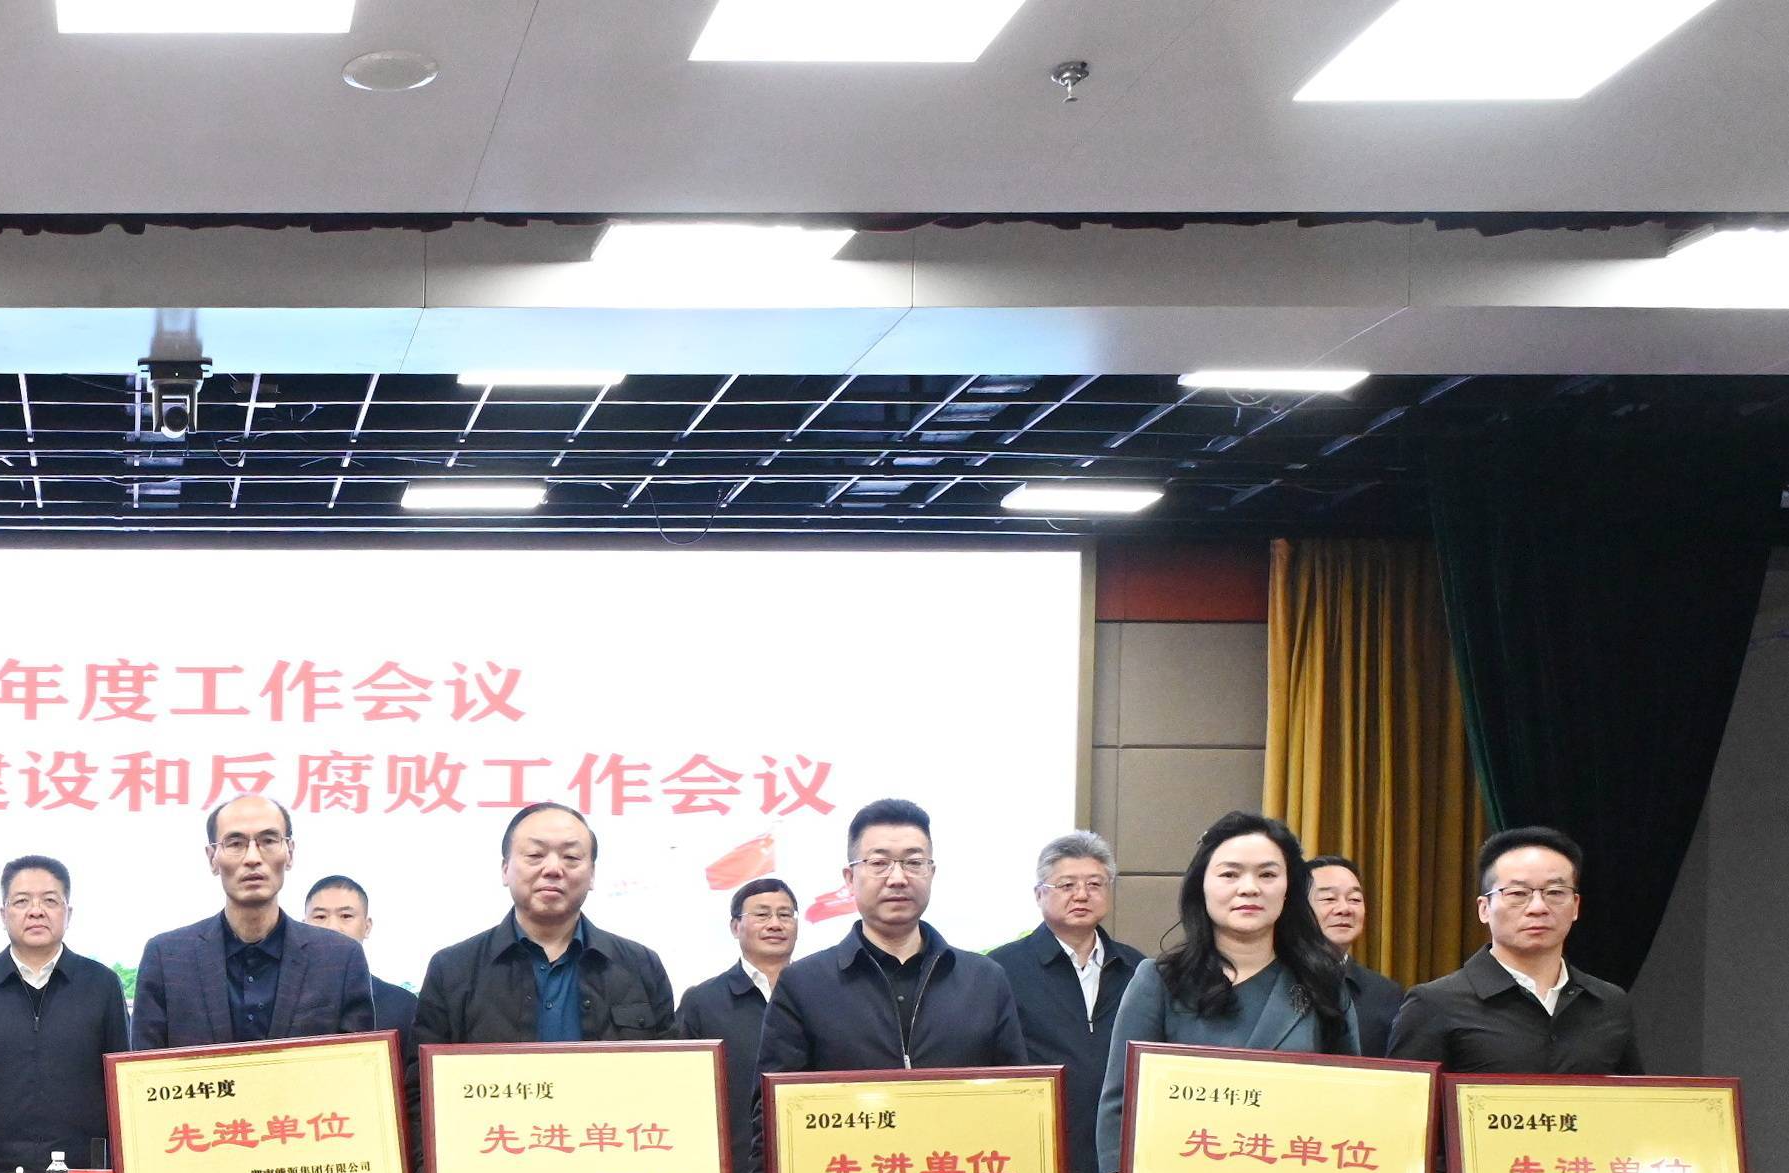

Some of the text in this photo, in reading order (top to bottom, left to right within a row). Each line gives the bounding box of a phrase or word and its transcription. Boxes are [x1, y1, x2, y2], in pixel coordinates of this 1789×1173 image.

[146, 1078, 236, 1102] 2024年度
[462, 1081, 555, 1101] 2024年度
[1168, 1084, 1263, 1109] 2024年度
[805, 1110, 897, 1130] 2024年度
[1487, 1113, 1578, 1132] 2024年度
[164, 1112, 354, 1154] 先进单位
[480, 1122, 673, 1156] 先进单位
[1178, 1129, 1380, 1172] 先进单位
